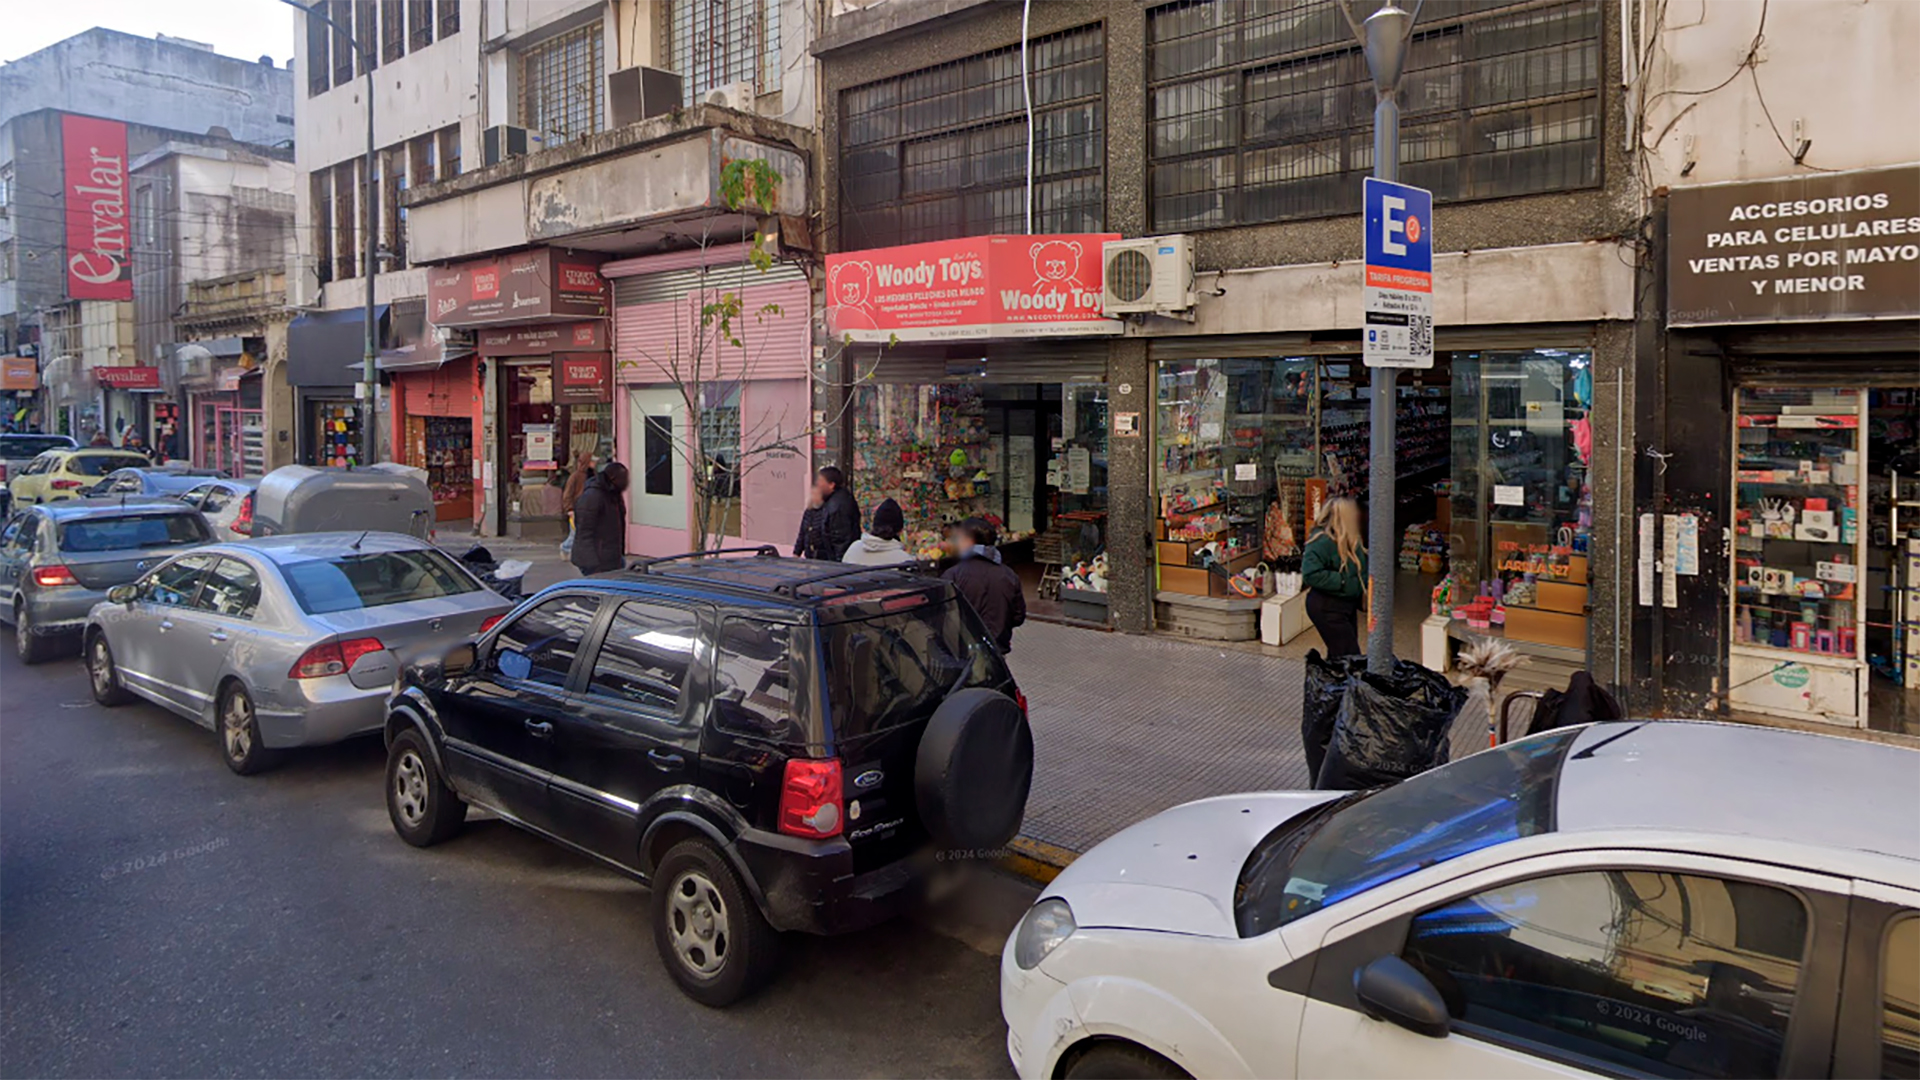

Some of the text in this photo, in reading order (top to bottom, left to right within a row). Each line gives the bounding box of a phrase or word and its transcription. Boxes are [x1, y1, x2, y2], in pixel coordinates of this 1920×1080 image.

[1729, 193, 1889, 221] ACCESORIOS
[1382, 195, 1406, 256] E
[1707, 217, 1920, 248] PARA CELULARES
[876, 258, 982, 288] Woody Toys
[1688, 245, 1920, 274] VENTAS POR MAYO
[1369, 272, 1391, 282] TARIFA
[1752, 275, 1865, 295] Y MENOR
[947, 288, 958, 297] DEL
[960, 287, 985, 296] MUNDO
[1000, 286, 1068, 312] Woody
